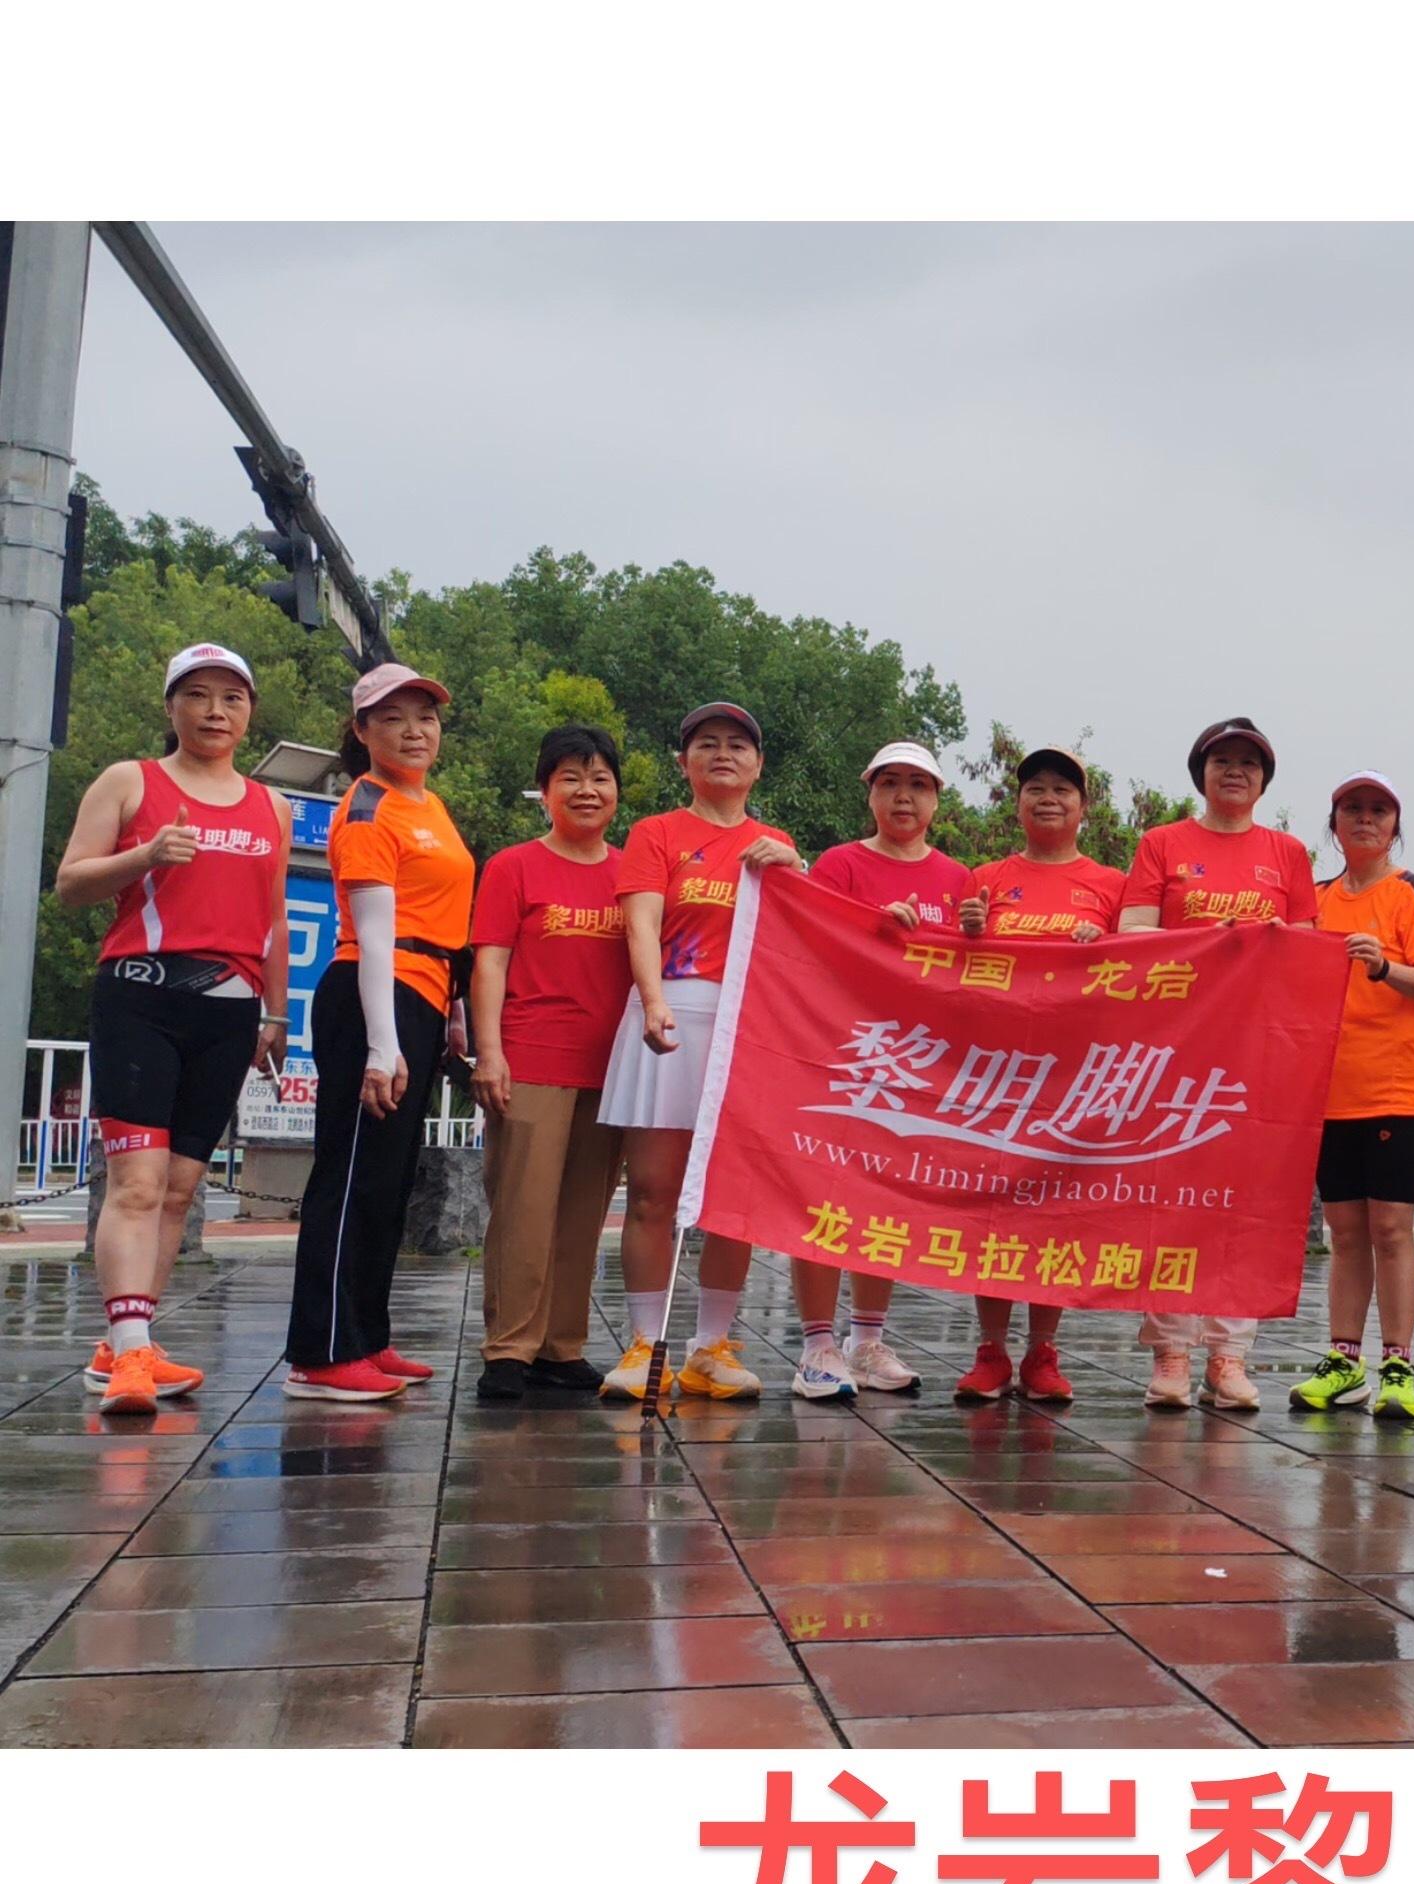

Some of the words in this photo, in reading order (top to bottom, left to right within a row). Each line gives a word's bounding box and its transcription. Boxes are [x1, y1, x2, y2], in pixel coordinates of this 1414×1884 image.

[680, 877, 738, 905] 黎明
[1183, 889, 1276, 921] 黎明脚步
[994, 911, 1086, 935] 黎明脚
[247, 1086, 273, 1098] 0597
[828, 1019, 1248, 1146] 黎明脚步
[791, 1128, 1237, 1210] www.limingjiaobu.net
[801, 1200, 1199, 1294] 龙岩马拉松跑团
